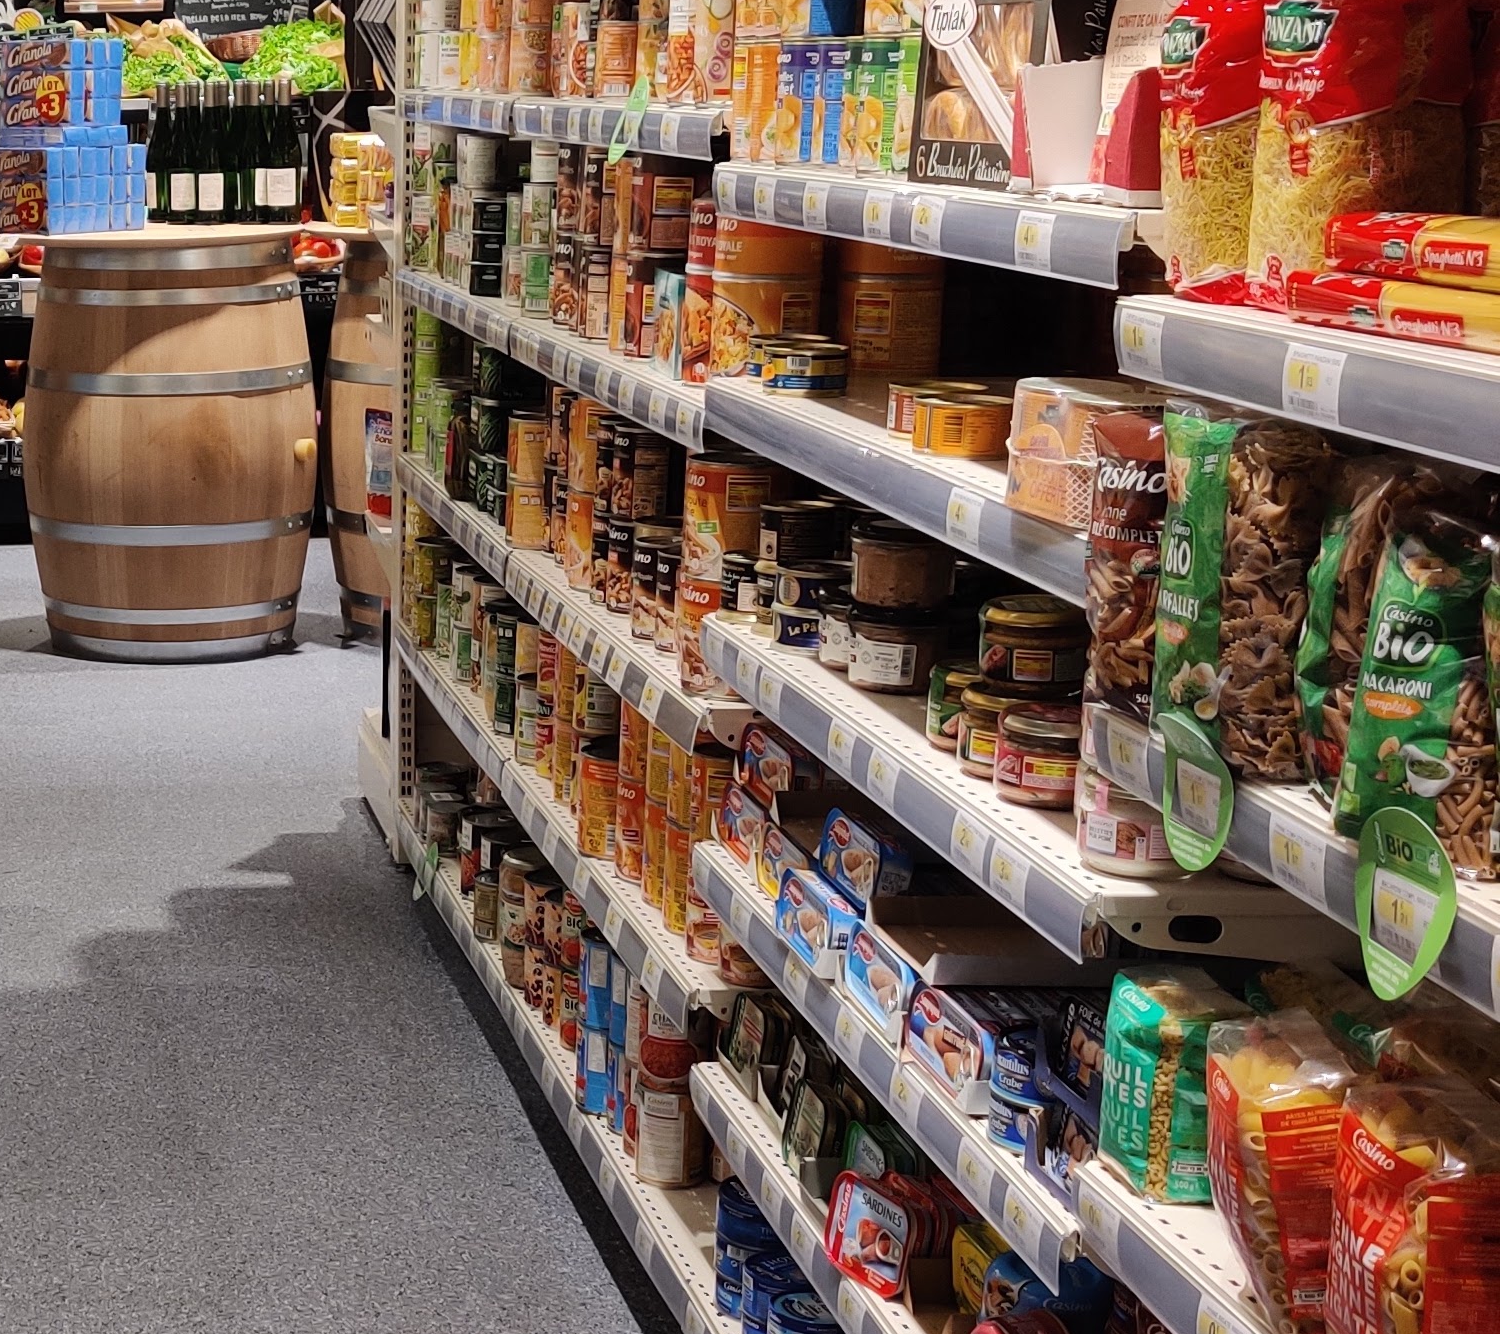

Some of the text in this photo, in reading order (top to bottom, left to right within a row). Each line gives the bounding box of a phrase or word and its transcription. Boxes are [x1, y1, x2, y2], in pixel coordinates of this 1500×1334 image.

[1264, 13, 1335, 44] PANZANI
[7, 42, 52, 69] Granola
[41, 80, 60, 91] LOT
[1285, 72, 1325, 95] d'Ange
[41, 94, 60, 116] x3
[915, 144, 968, 182] 6 Bouchées
[20, 187, 37, 199] LOT
[21, 202, 39, 223] x3
[1423, 244, 1464, 266] Spaghetti
[1394, 312, 1440, 336] Spaghetti
[1164, 537, 1191, 576] BiO
[1383, 602, 1435, 629] Casino
[1372, 621, 1436, 666] BiO
[1361, 670, 1433, 699] MACARONI
[1384, 833, 1413, 862] BiO
[1117, 985, 1151, 1013] Casino
[998, 1072, 1023, 1091] Crabe
[1352, 1128, 1396, 1171] Casino
[837, 1182, 852, 1234] Casino
[861, 1191, 903, 1229] SARDINES
